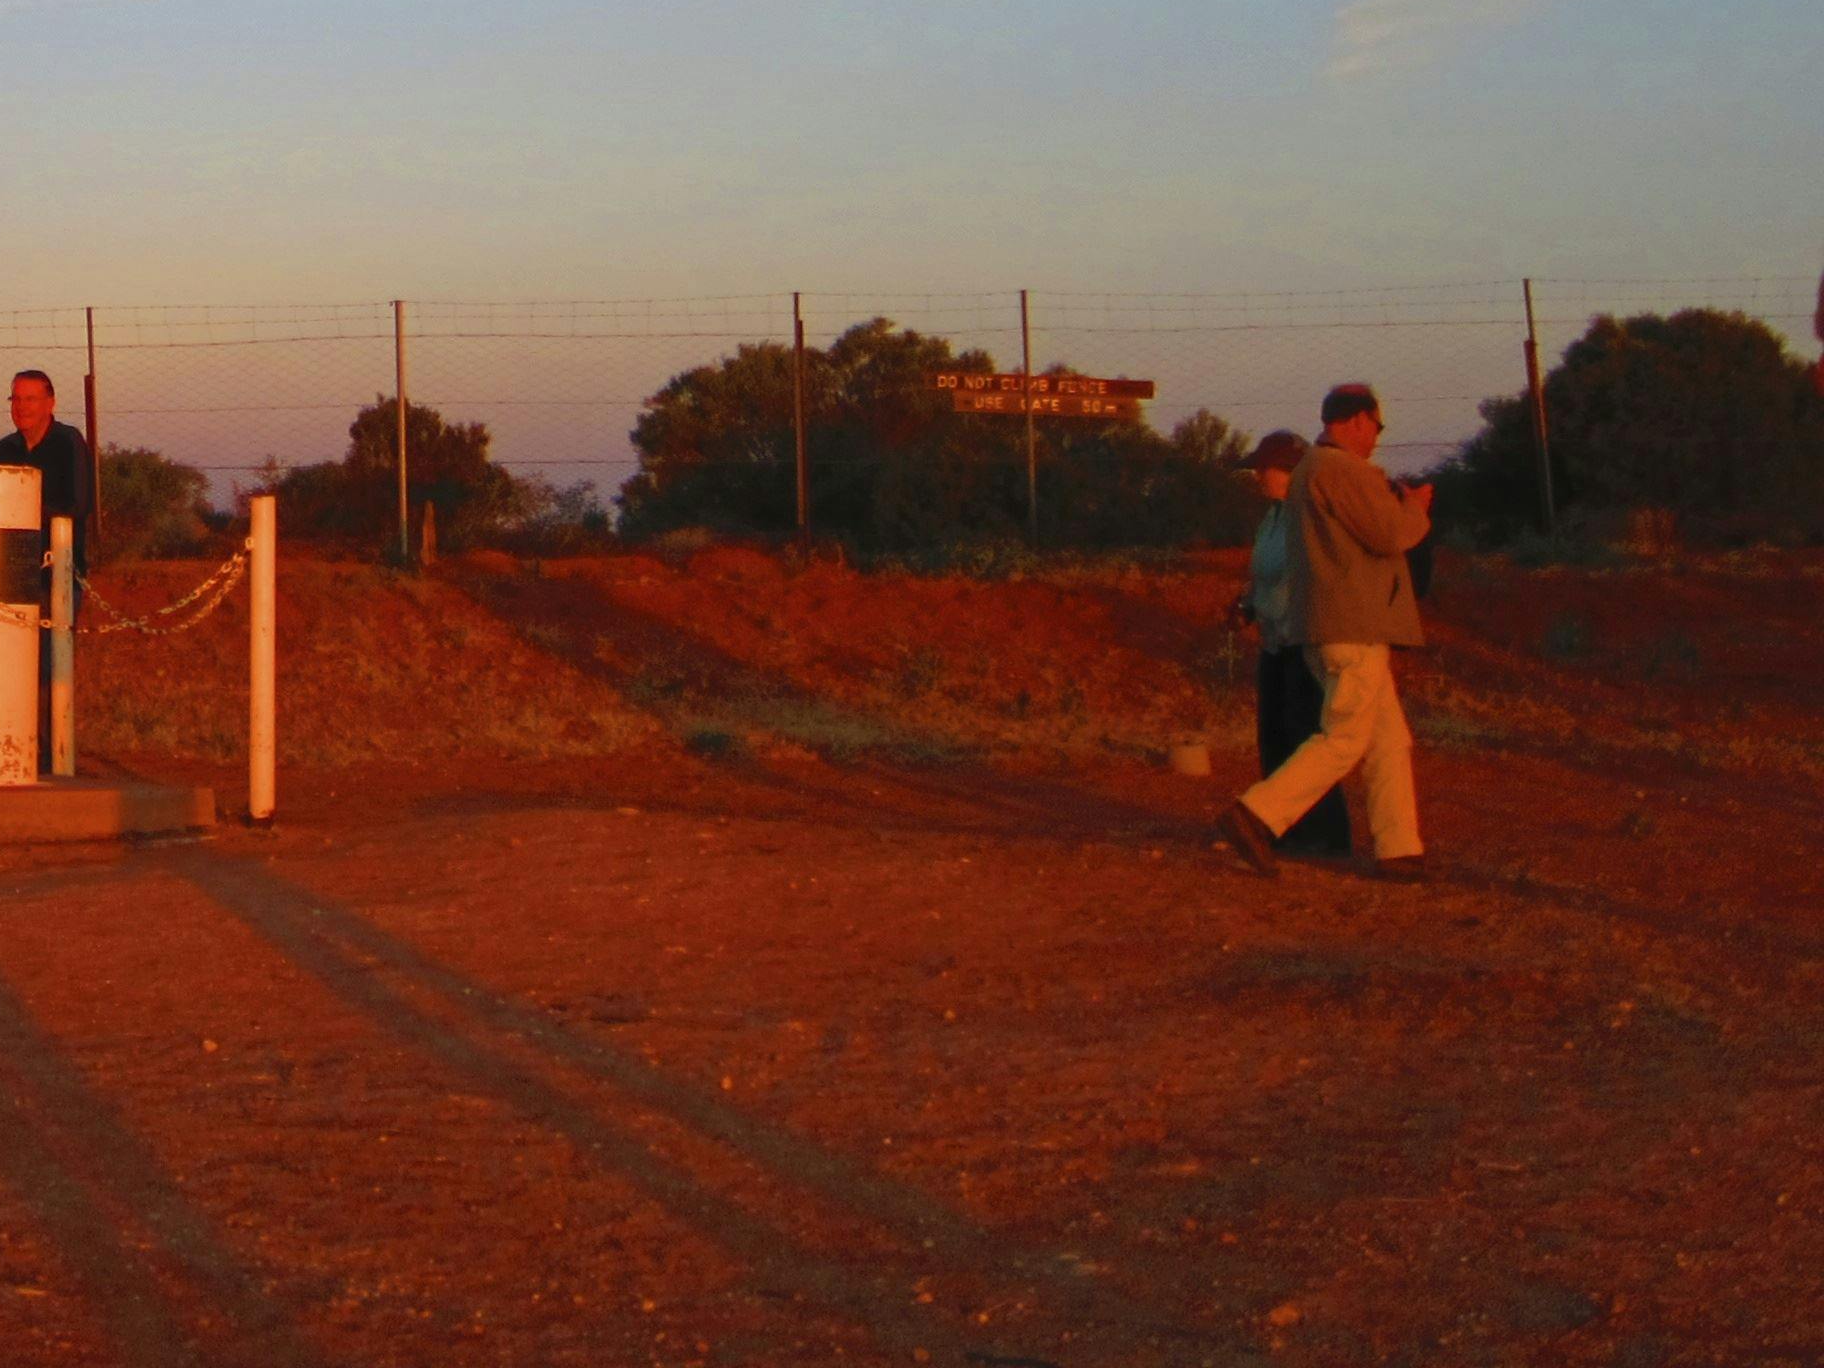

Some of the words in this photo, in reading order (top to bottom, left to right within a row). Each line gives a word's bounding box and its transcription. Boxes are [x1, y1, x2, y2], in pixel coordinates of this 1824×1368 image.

[937, 375, 958, 389] DO
[964, 376, 993, 390] NOT
[1057, 380, 1107, 395] FENCE
[974, 396, 1004, 410] USE
